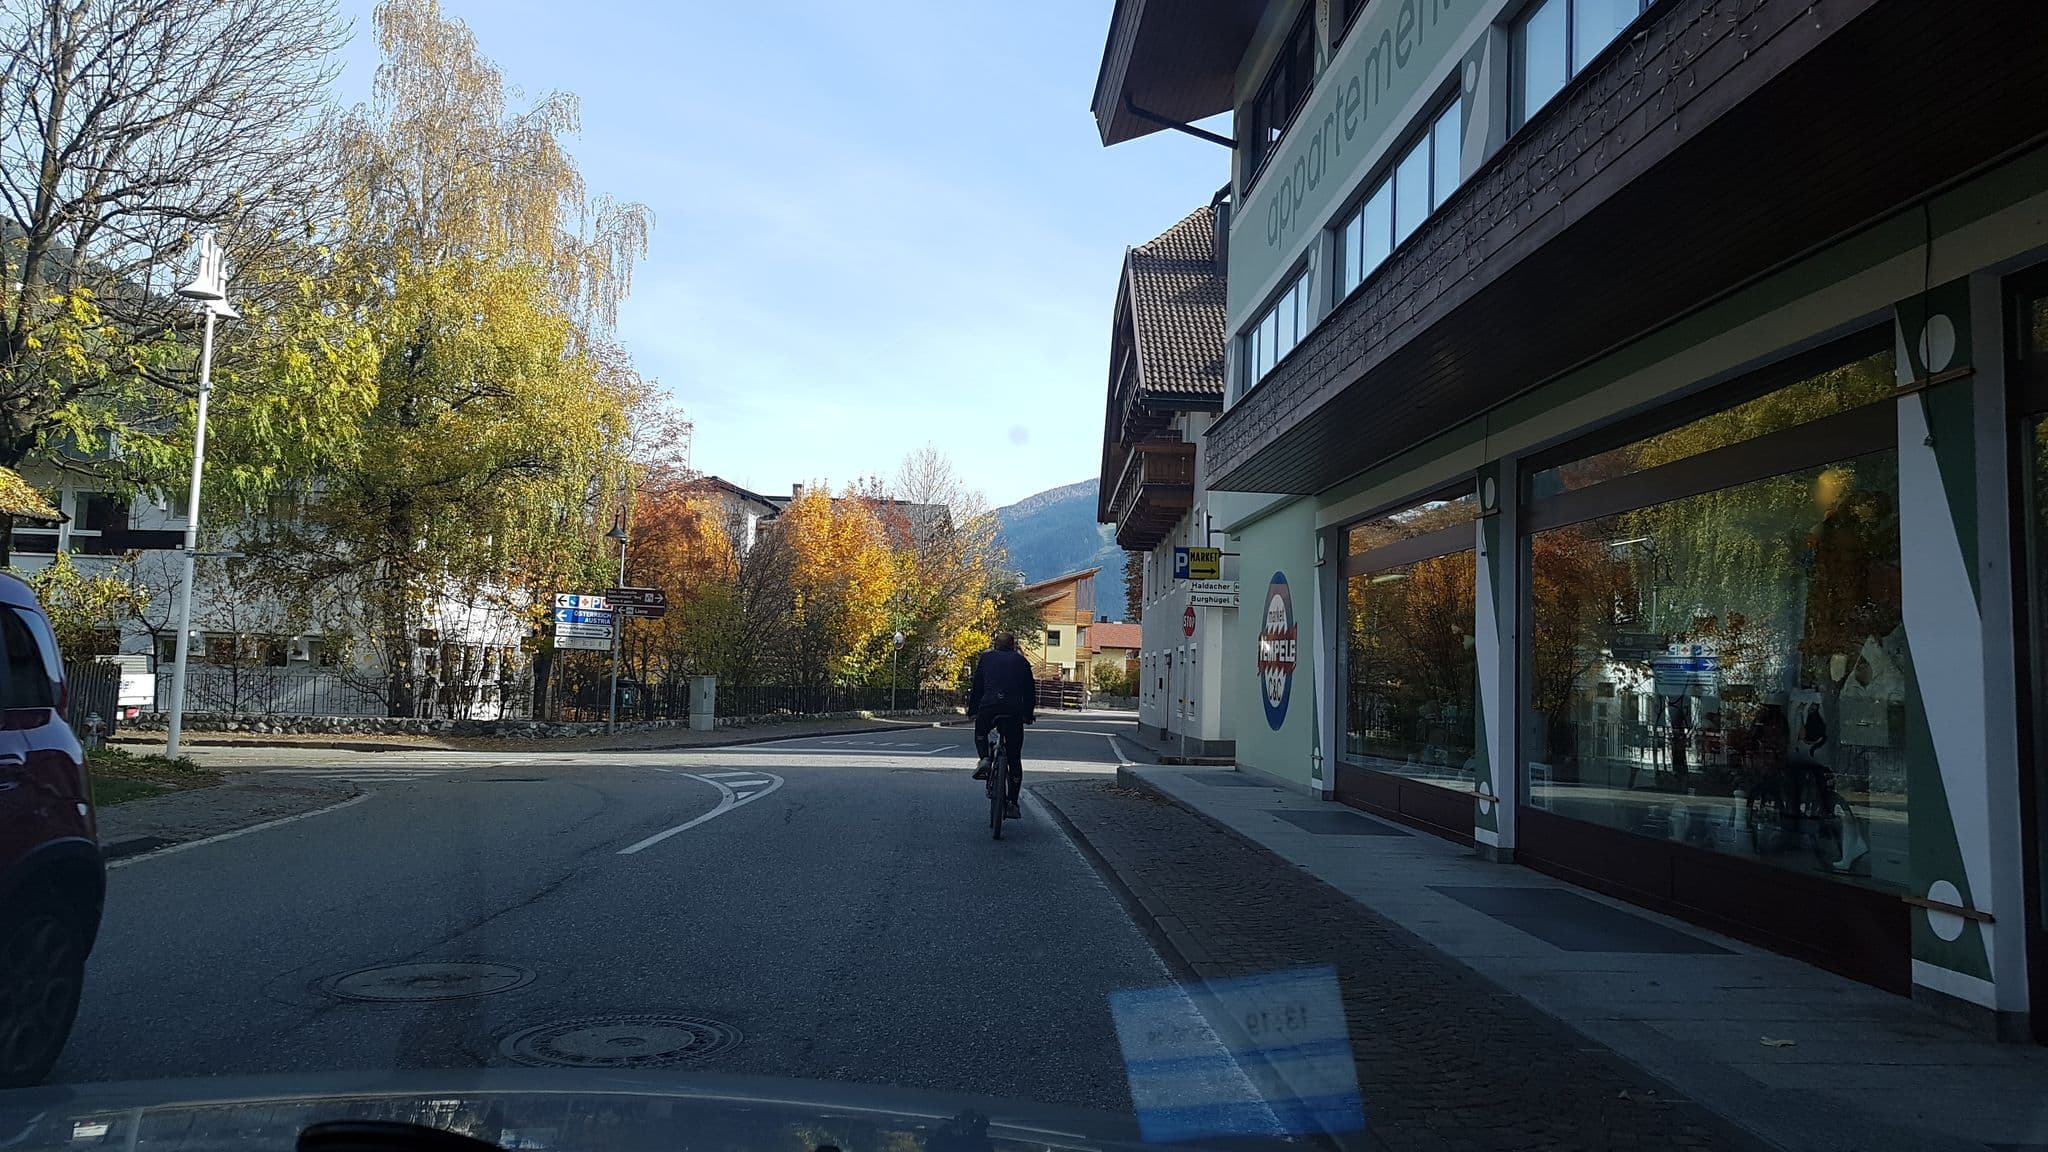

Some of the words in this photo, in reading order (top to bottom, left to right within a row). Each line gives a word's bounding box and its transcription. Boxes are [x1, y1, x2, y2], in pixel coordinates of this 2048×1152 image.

[1176, 553, 1188, 573] P
[1190, 551, 1218, 563] MARKET
[1191, 582, 1230, 590] Haldacher
[584, 617, 611, 625] AUSTRIA
[1183, 615, 1195, 628] STOP
[1269, 606, 1285, 623] market
[1268, 677, 1282, 701] C&C
